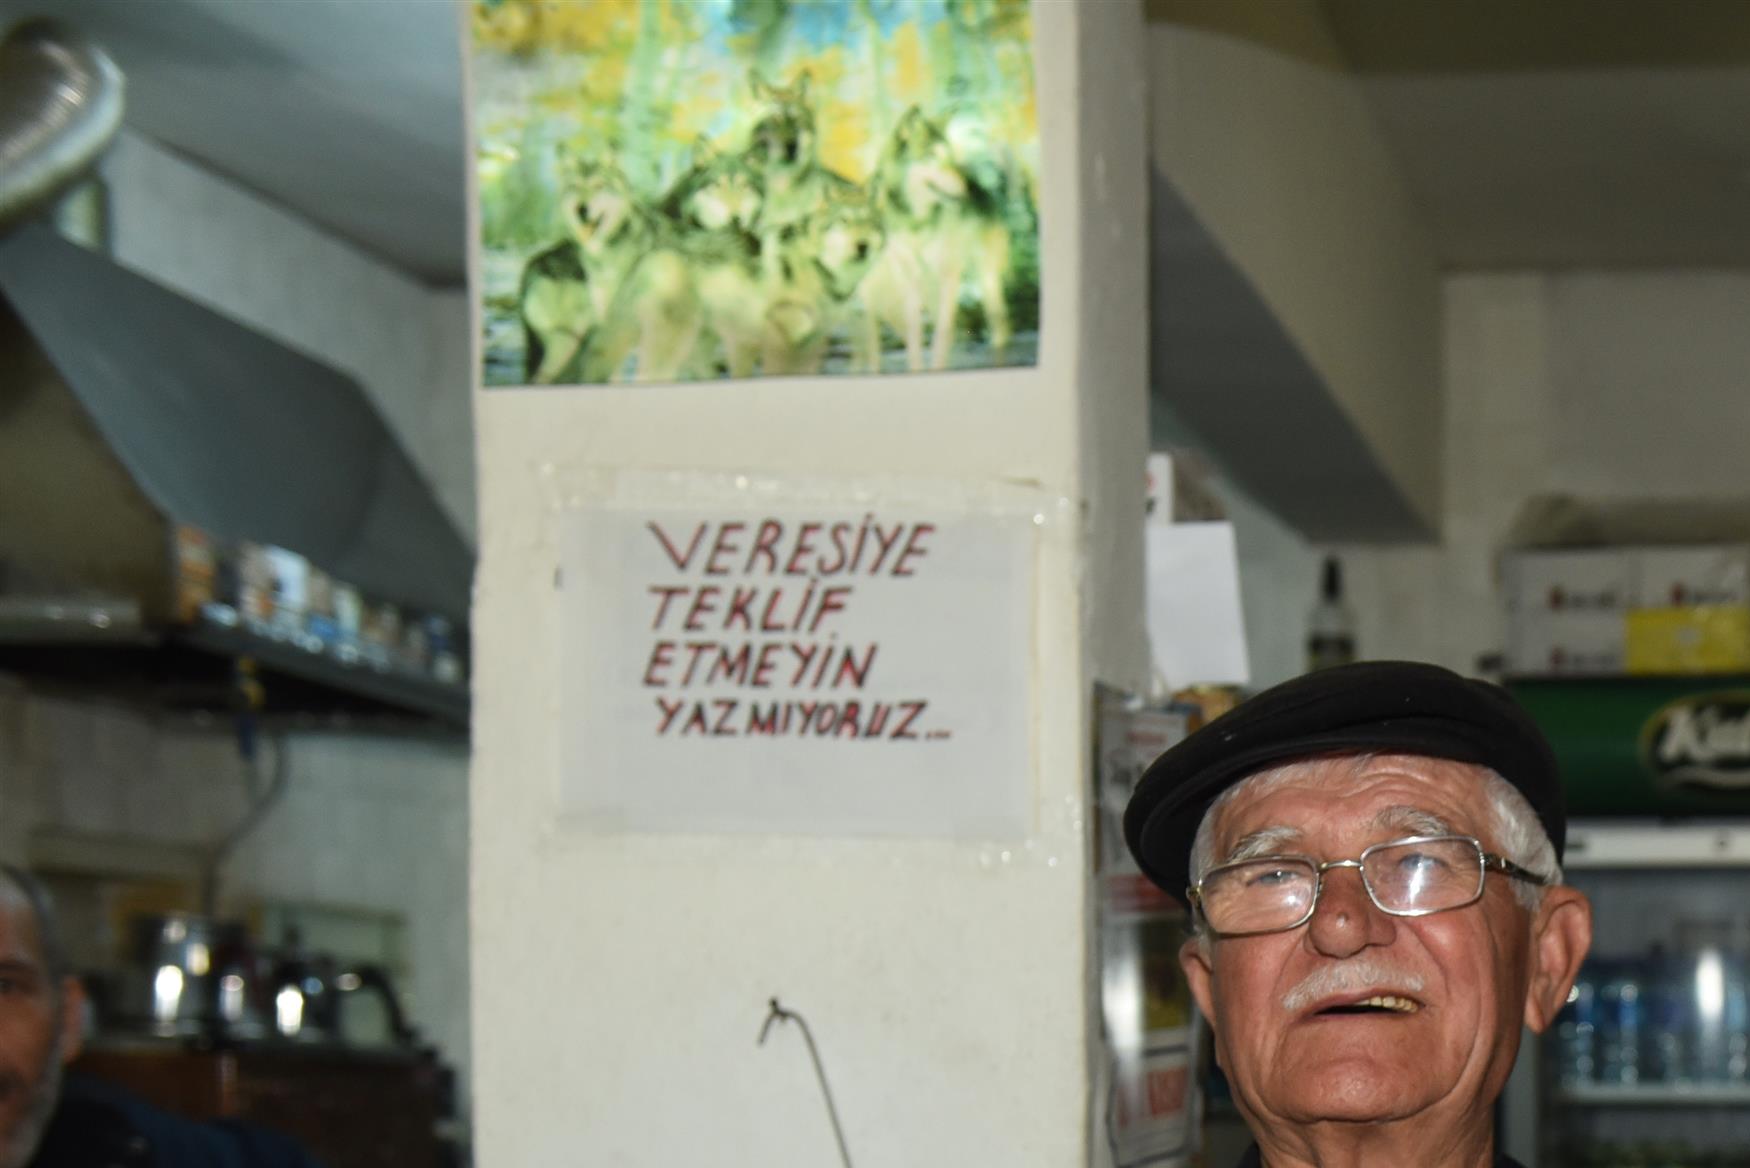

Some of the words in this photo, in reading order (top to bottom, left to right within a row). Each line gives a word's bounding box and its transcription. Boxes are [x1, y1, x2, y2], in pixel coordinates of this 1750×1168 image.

[646, 513, 936, 577] VERESİYE
[647, 576, 853, 633] TEKLİF
[641, 632, 879, 690] ETMEYİN
